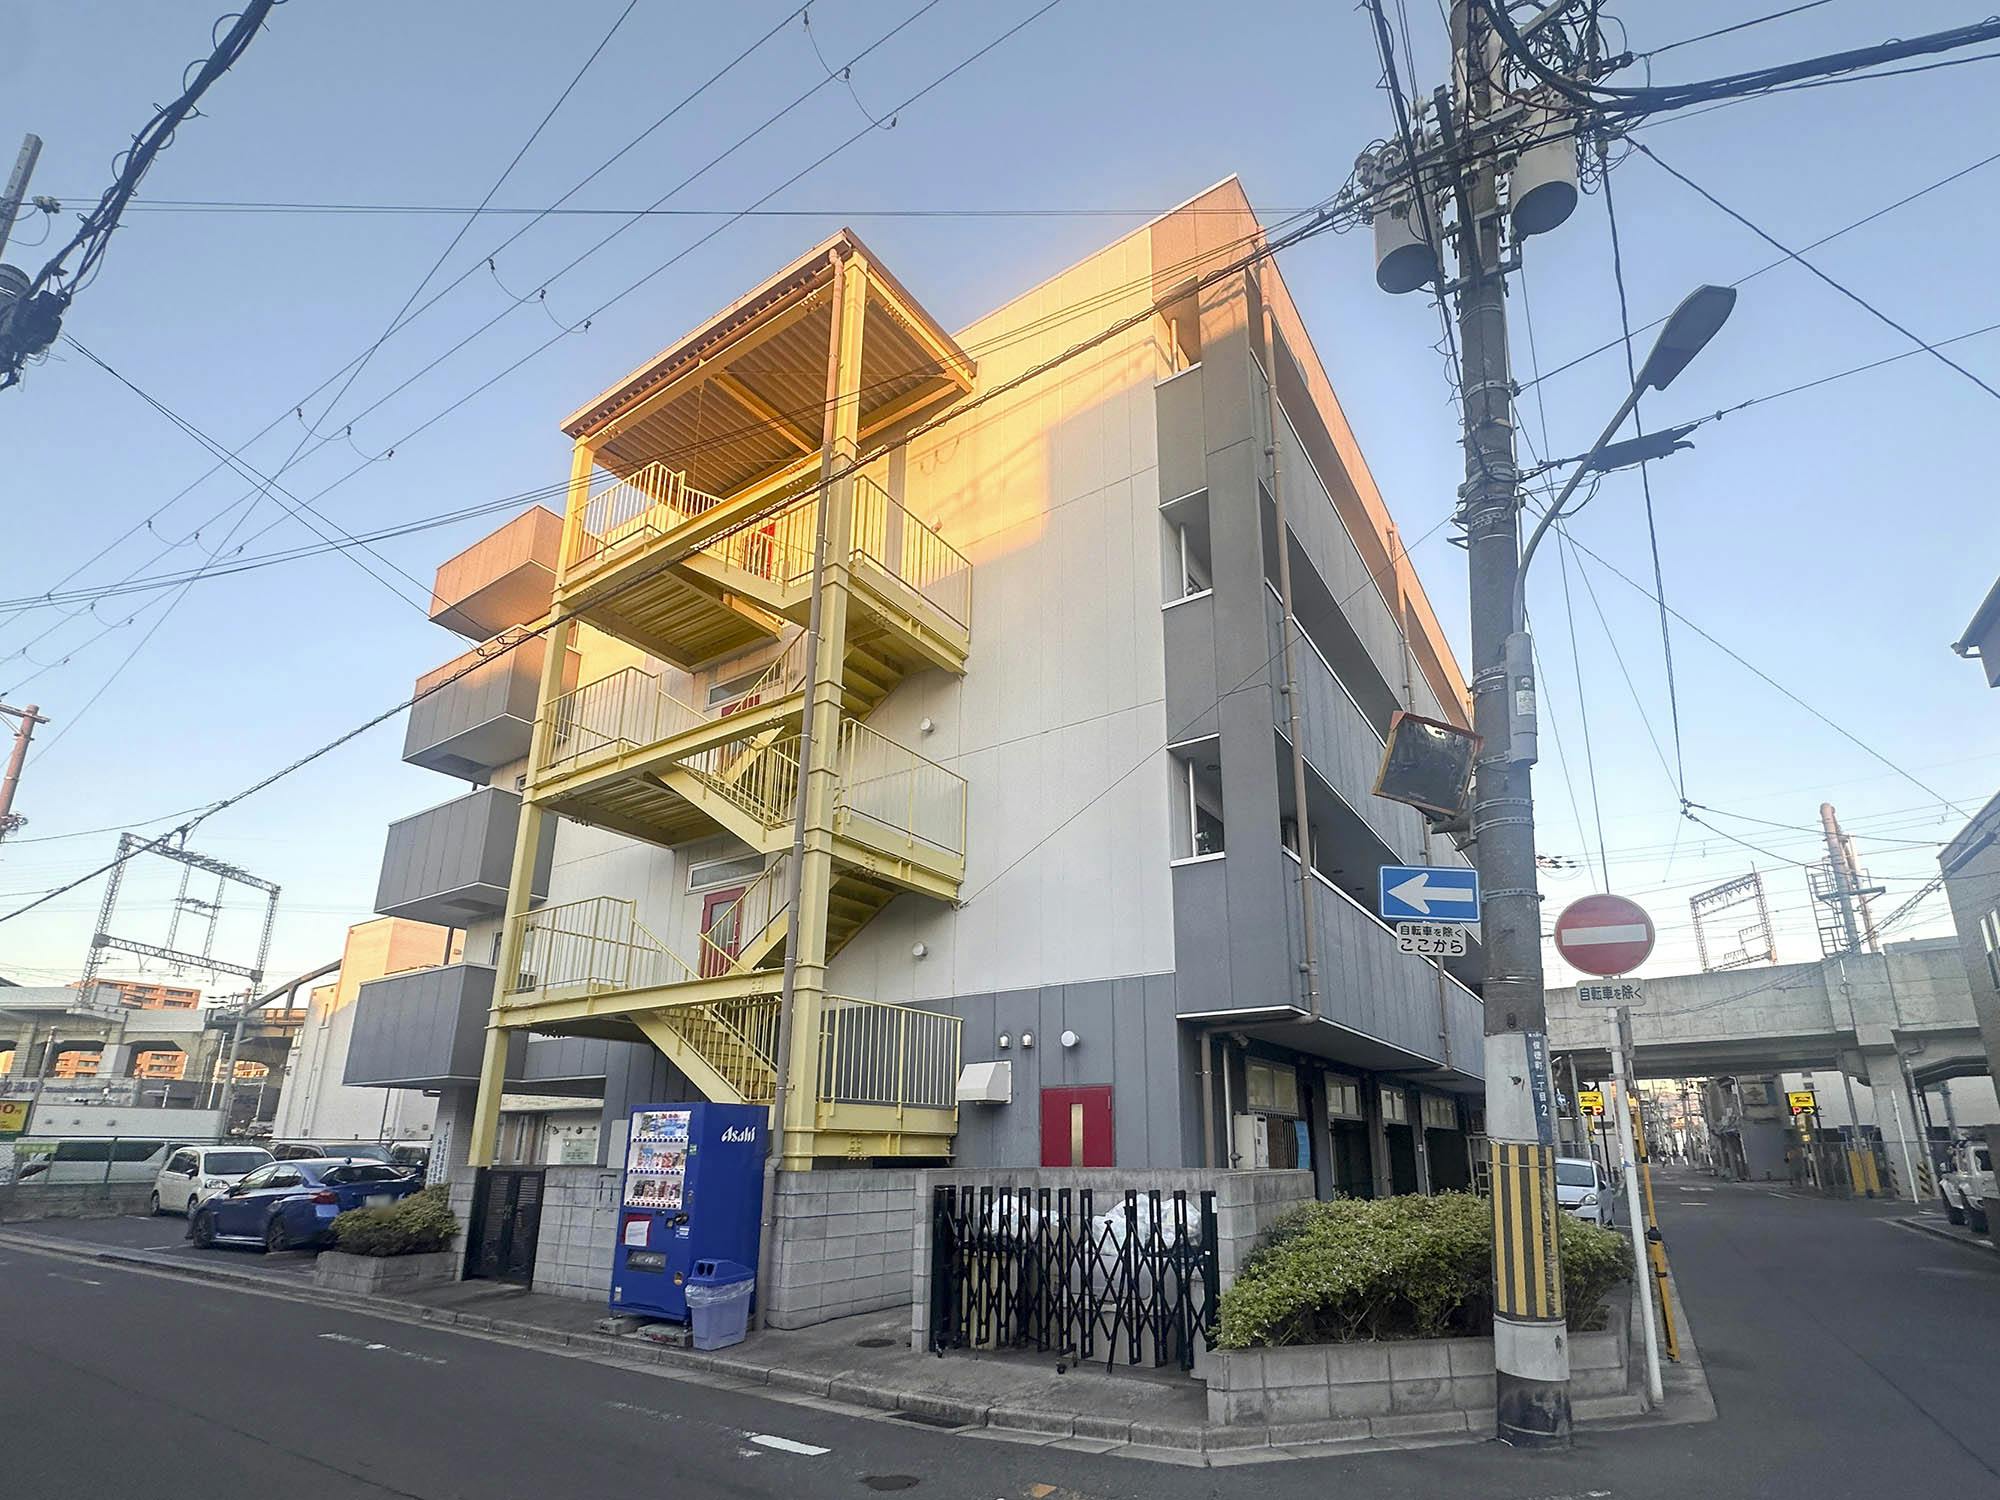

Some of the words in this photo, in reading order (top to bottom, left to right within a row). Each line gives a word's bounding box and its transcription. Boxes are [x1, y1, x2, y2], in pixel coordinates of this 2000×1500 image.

[1400, 925, 1462, 937] 自転車を除く
[1400, 938, 1464, 954] ここから
[1580, 984, 1642, 1001] 自転車を除く
[721, 1125, 756, 1142] Asahi
